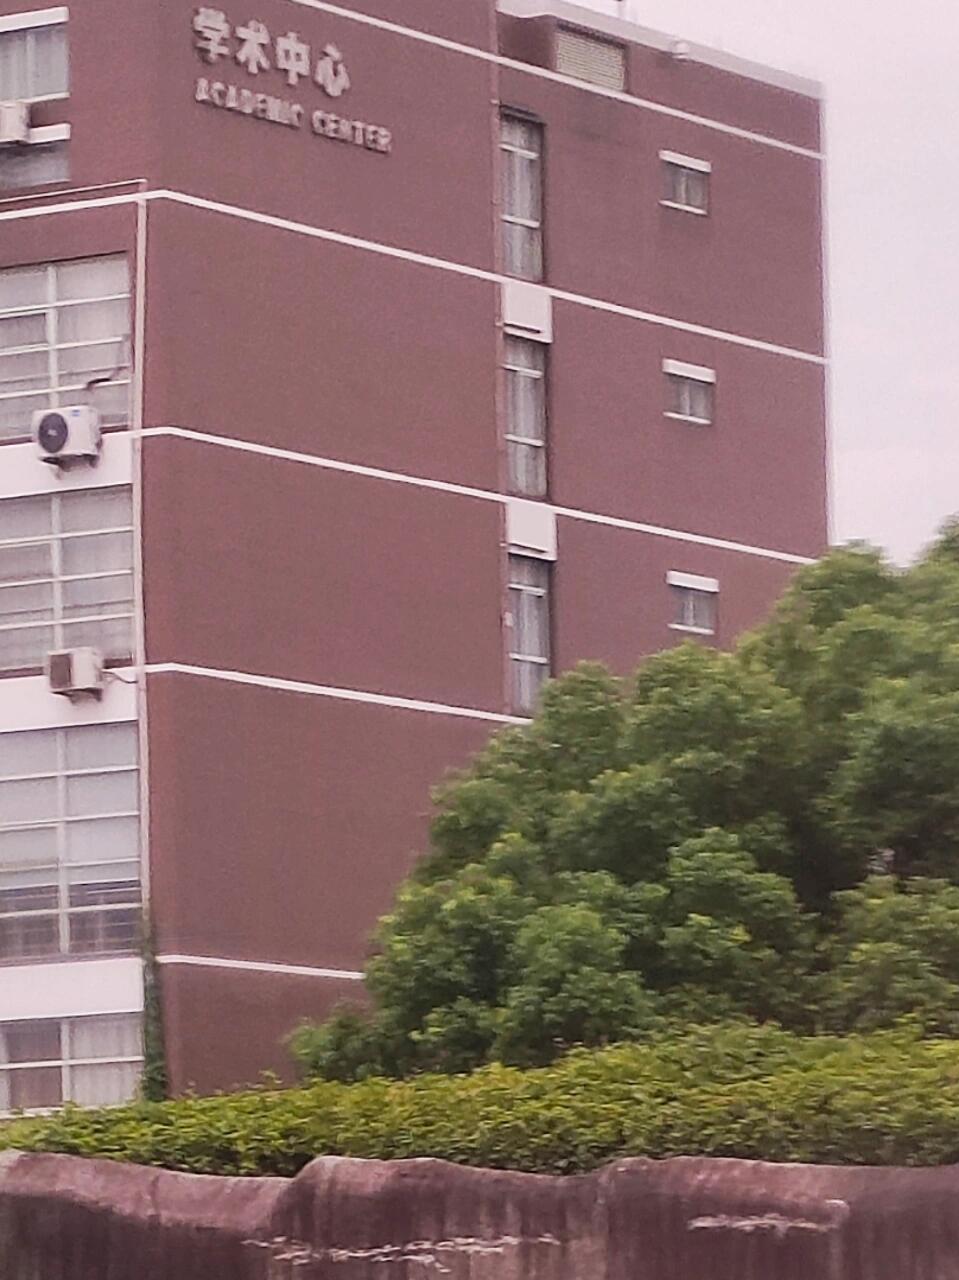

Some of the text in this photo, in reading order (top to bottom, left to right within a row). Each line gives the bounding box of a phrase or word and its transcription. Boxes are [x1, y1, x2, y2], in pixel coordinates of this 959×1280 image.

[193, 7, 350, 97] 学术中心
[195, 77, 393, 153] ACADEMIC CENTER
